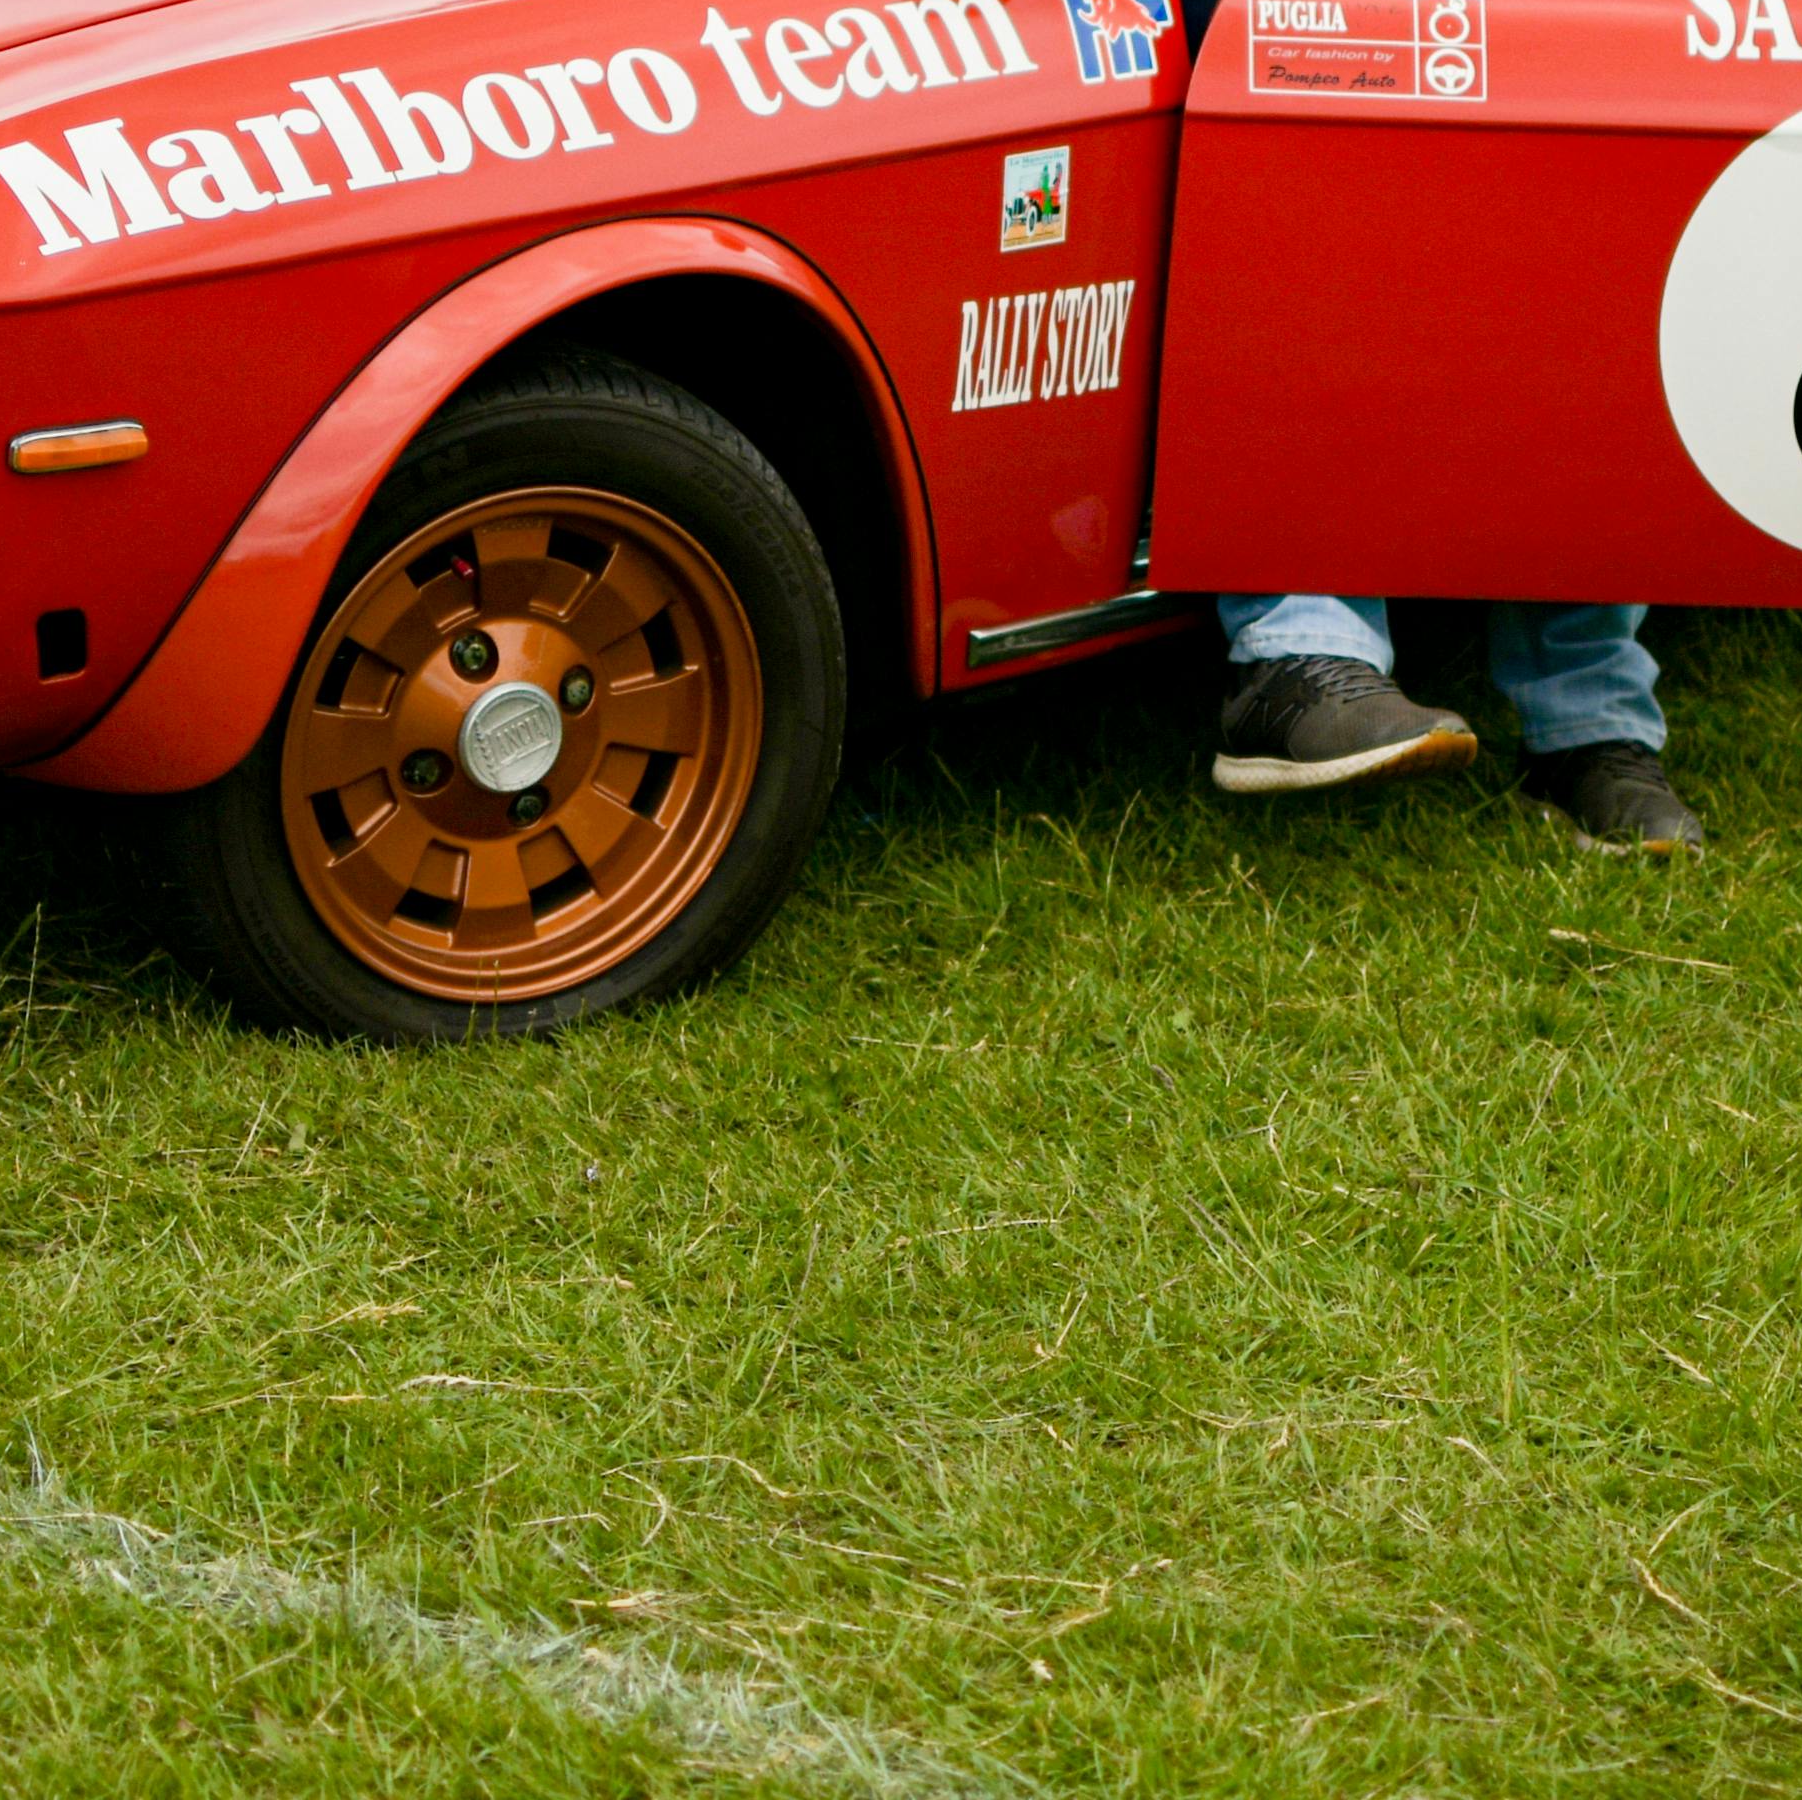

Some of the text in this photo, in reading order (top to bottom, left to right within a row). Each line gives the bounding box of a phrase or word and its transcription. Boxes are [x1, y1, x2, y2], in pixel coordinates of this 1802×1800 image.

[1267, 46, 1395, 63] Car fashion by
[1267, 64, 1397, 90] Pompeo Auto
[950, 279, 1136, 413] RALLY STORY
